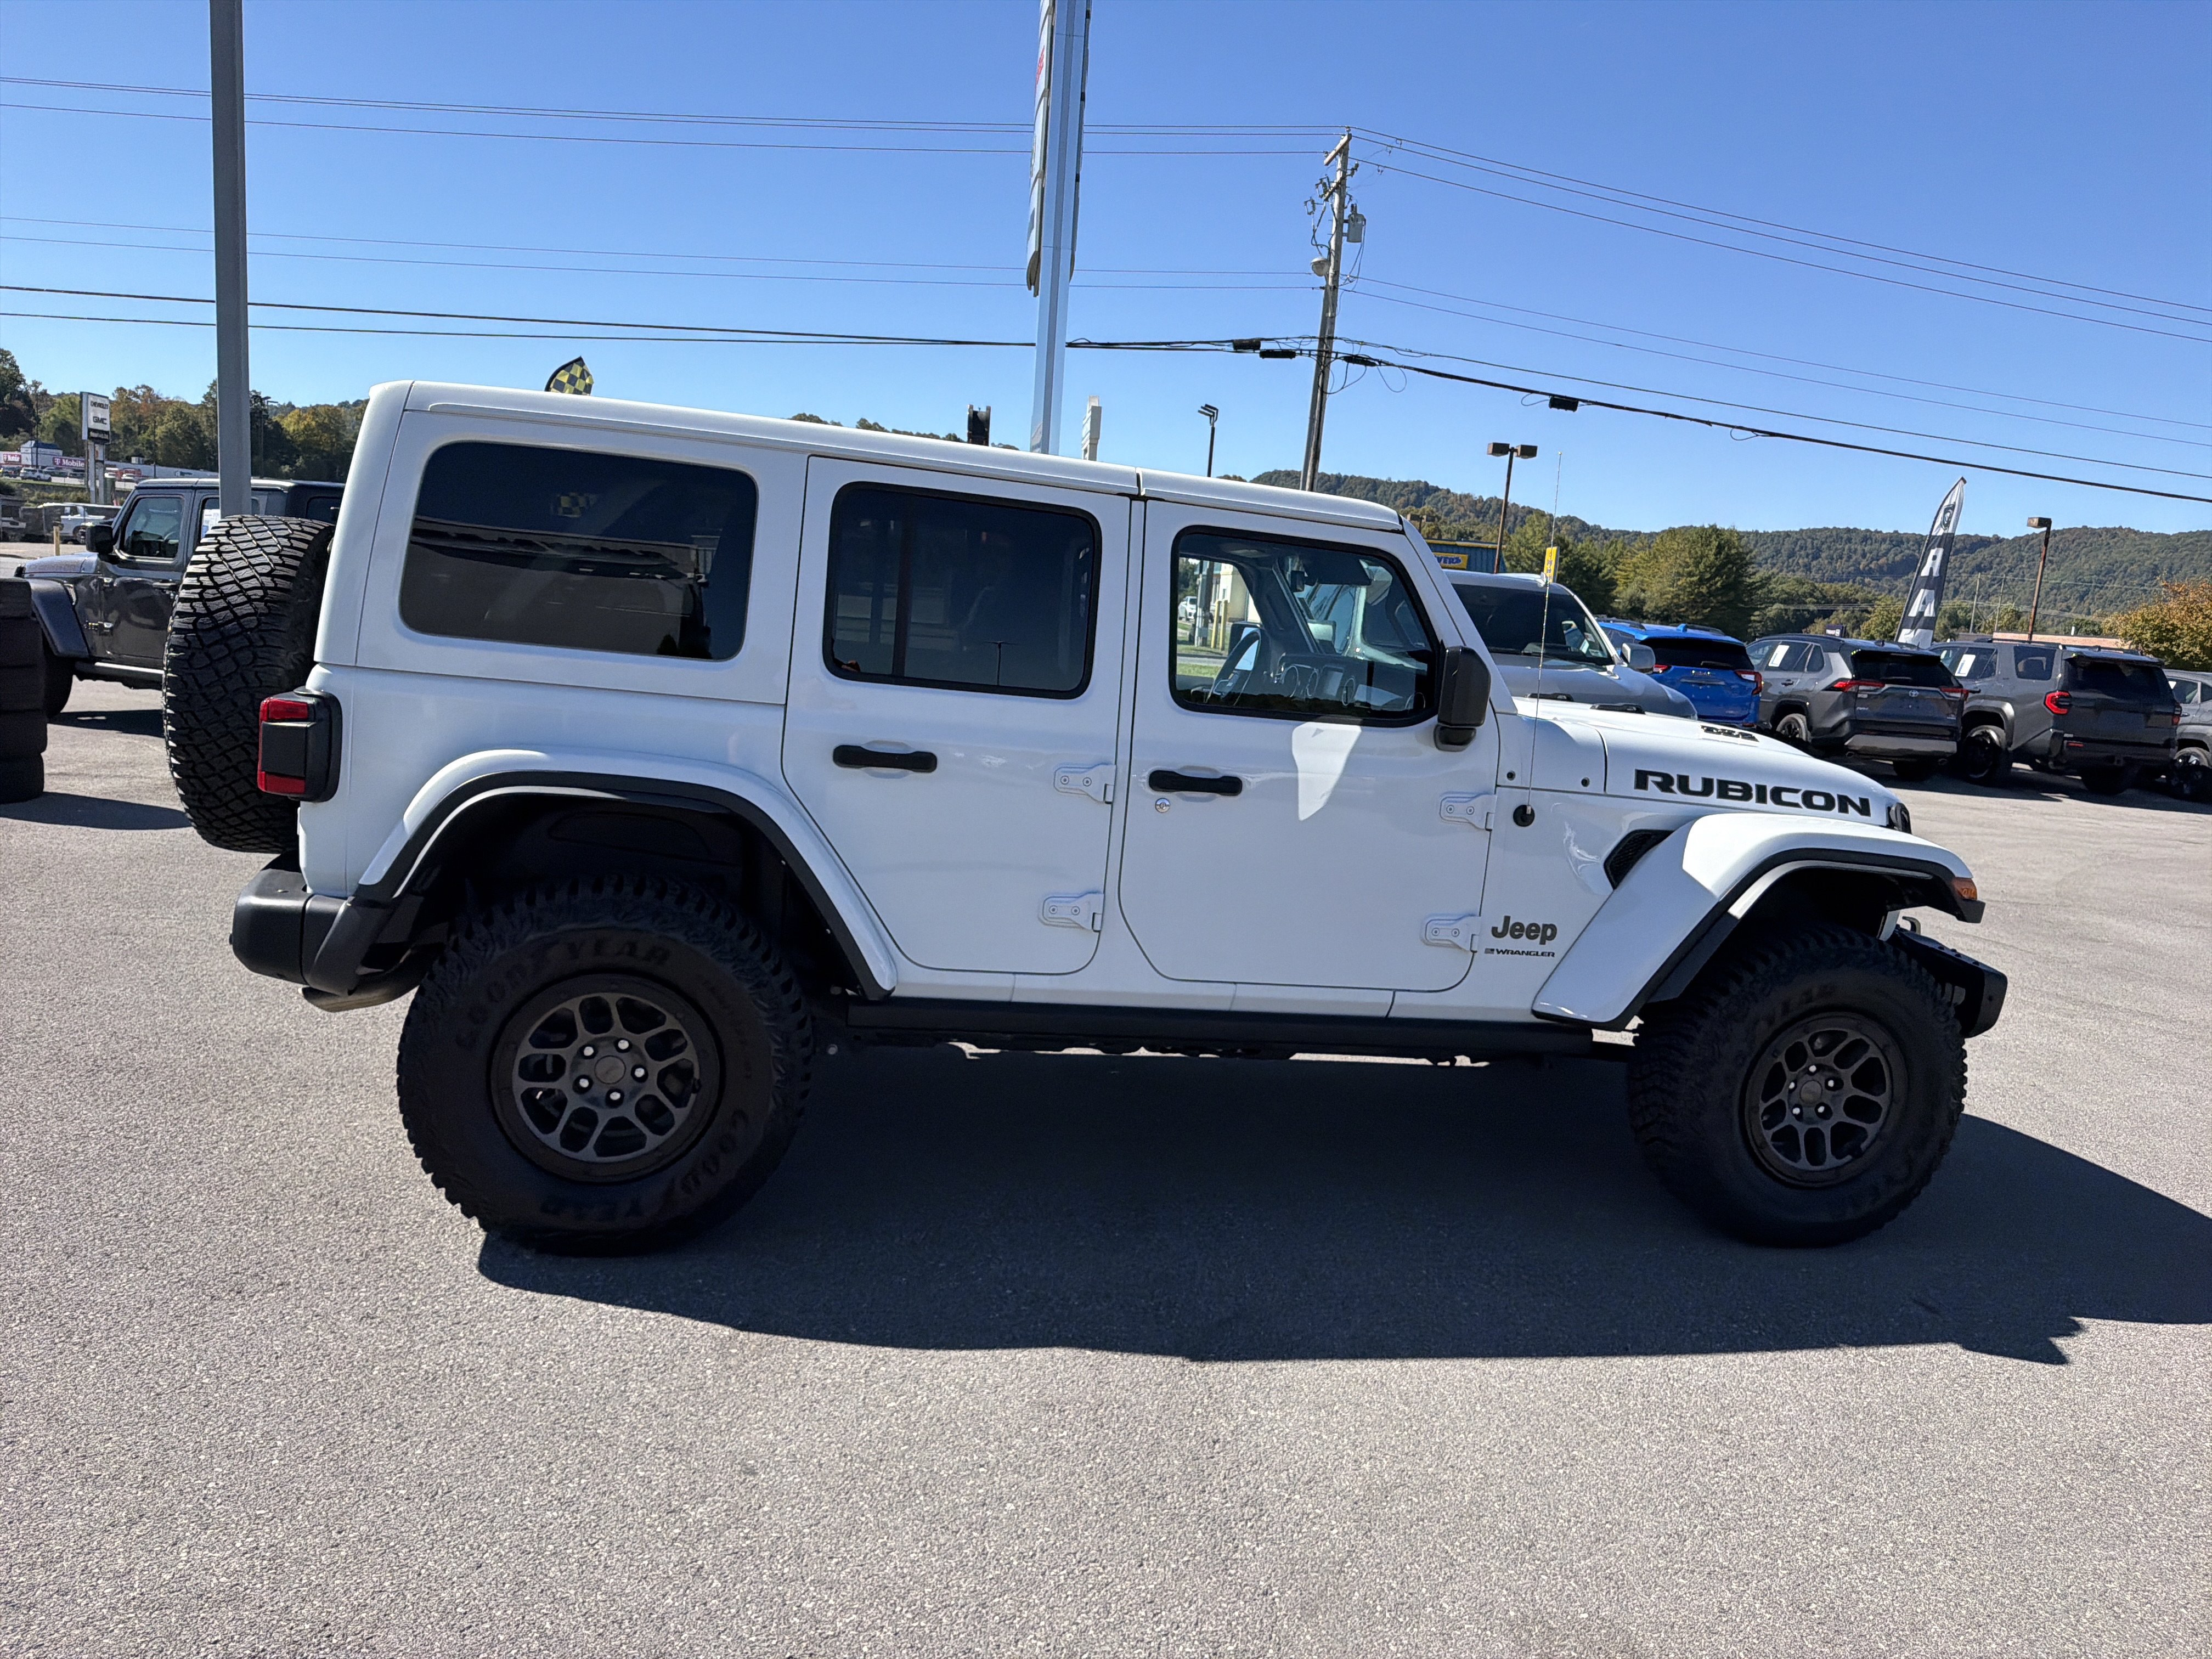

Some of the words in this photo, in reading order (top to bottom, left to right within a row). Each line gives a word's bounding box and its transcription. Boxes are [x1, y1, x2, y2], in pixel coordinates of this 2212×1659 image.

[93, 416, 107, 425] GMC
[62, 459, 84, 467] Mobile
[1435, 555, 1462, 565] VERS
[1634, 769, 1871, 817] RUBICON
[1491, 916, 1557, 945] Jeep
[1496, 949, 1555, 957] WRANGLER
